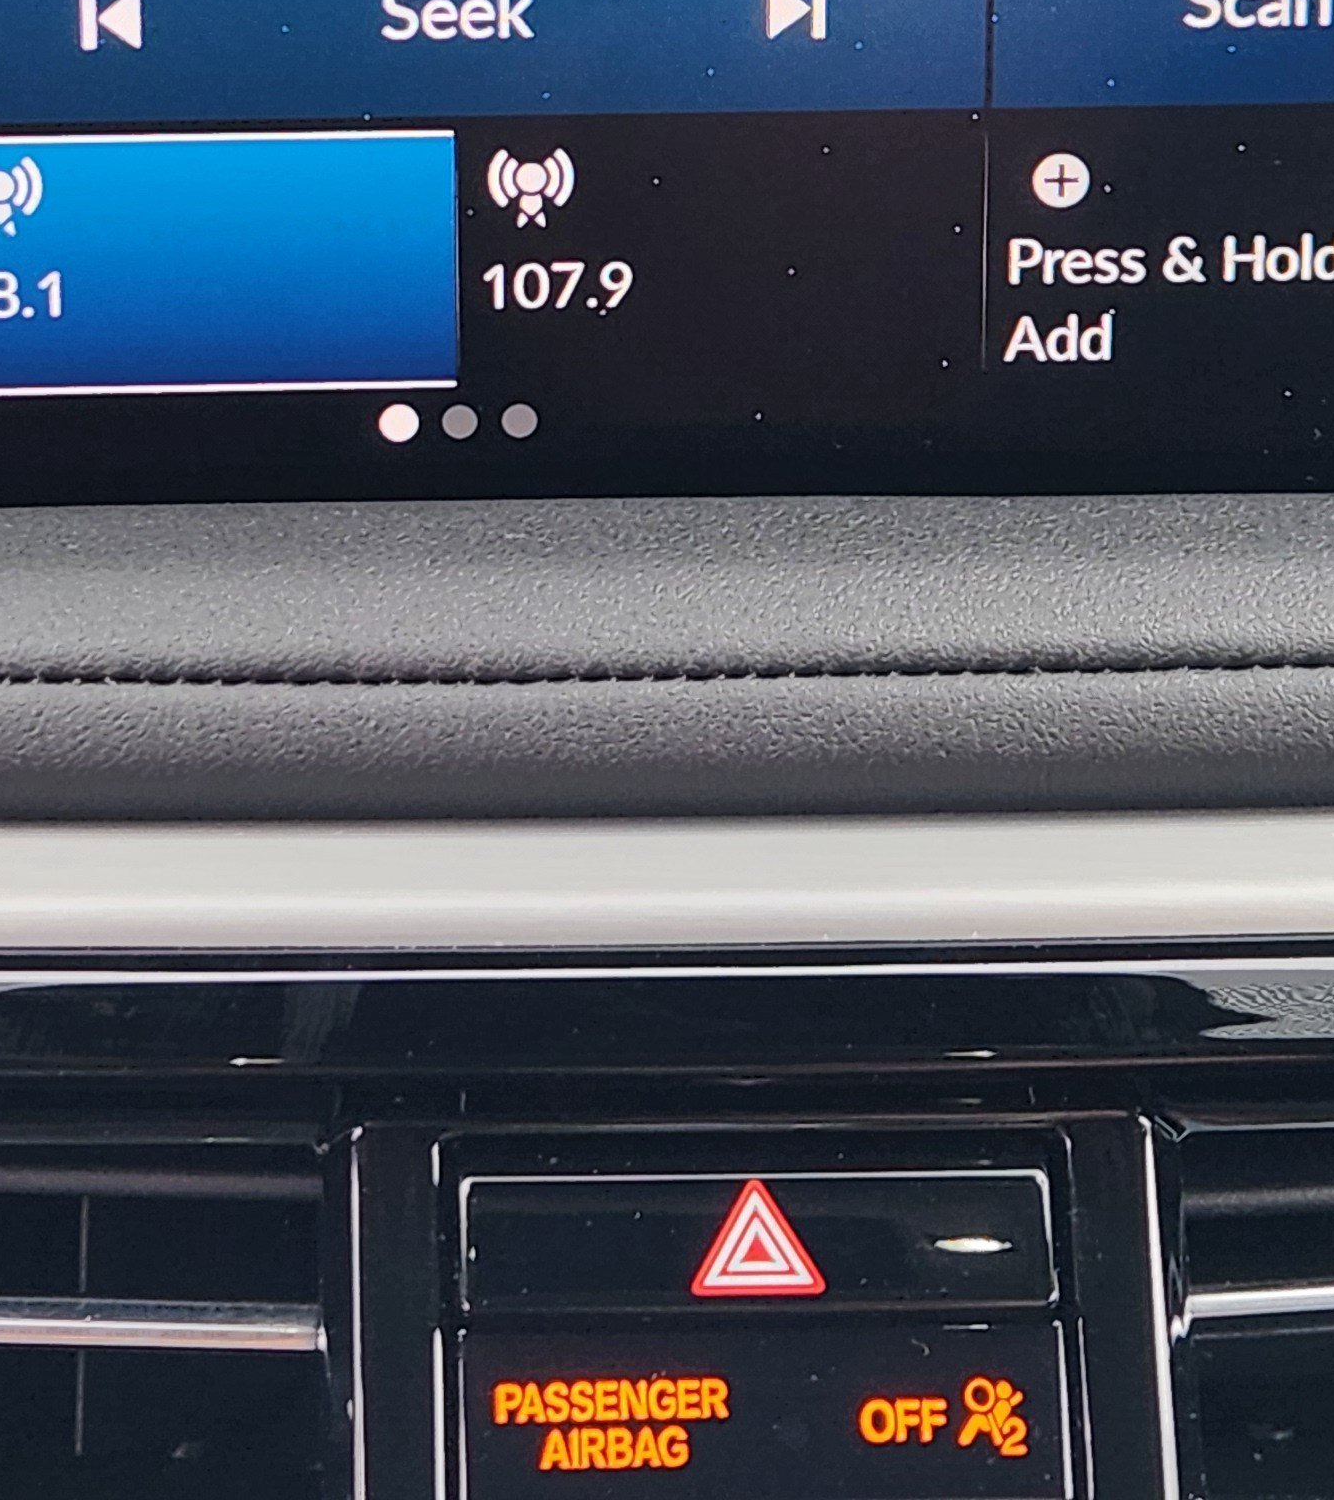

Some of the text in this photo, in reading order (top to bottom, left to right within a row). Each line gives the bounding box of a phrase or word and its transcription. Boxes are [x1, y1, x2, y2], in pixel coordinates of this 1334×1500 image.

[1006, 235, 1148, 285] Press
[1161, 237, 1206, 284] &
[482, 260, 636, 312] 107.9
[1001, 313, 1115, 363] Add
[493, 1378, 730, 1424] PASSENGER
[859, 1397, 949, 1445] OFF
[538, 1425, 689, 1470] AIRBAG
